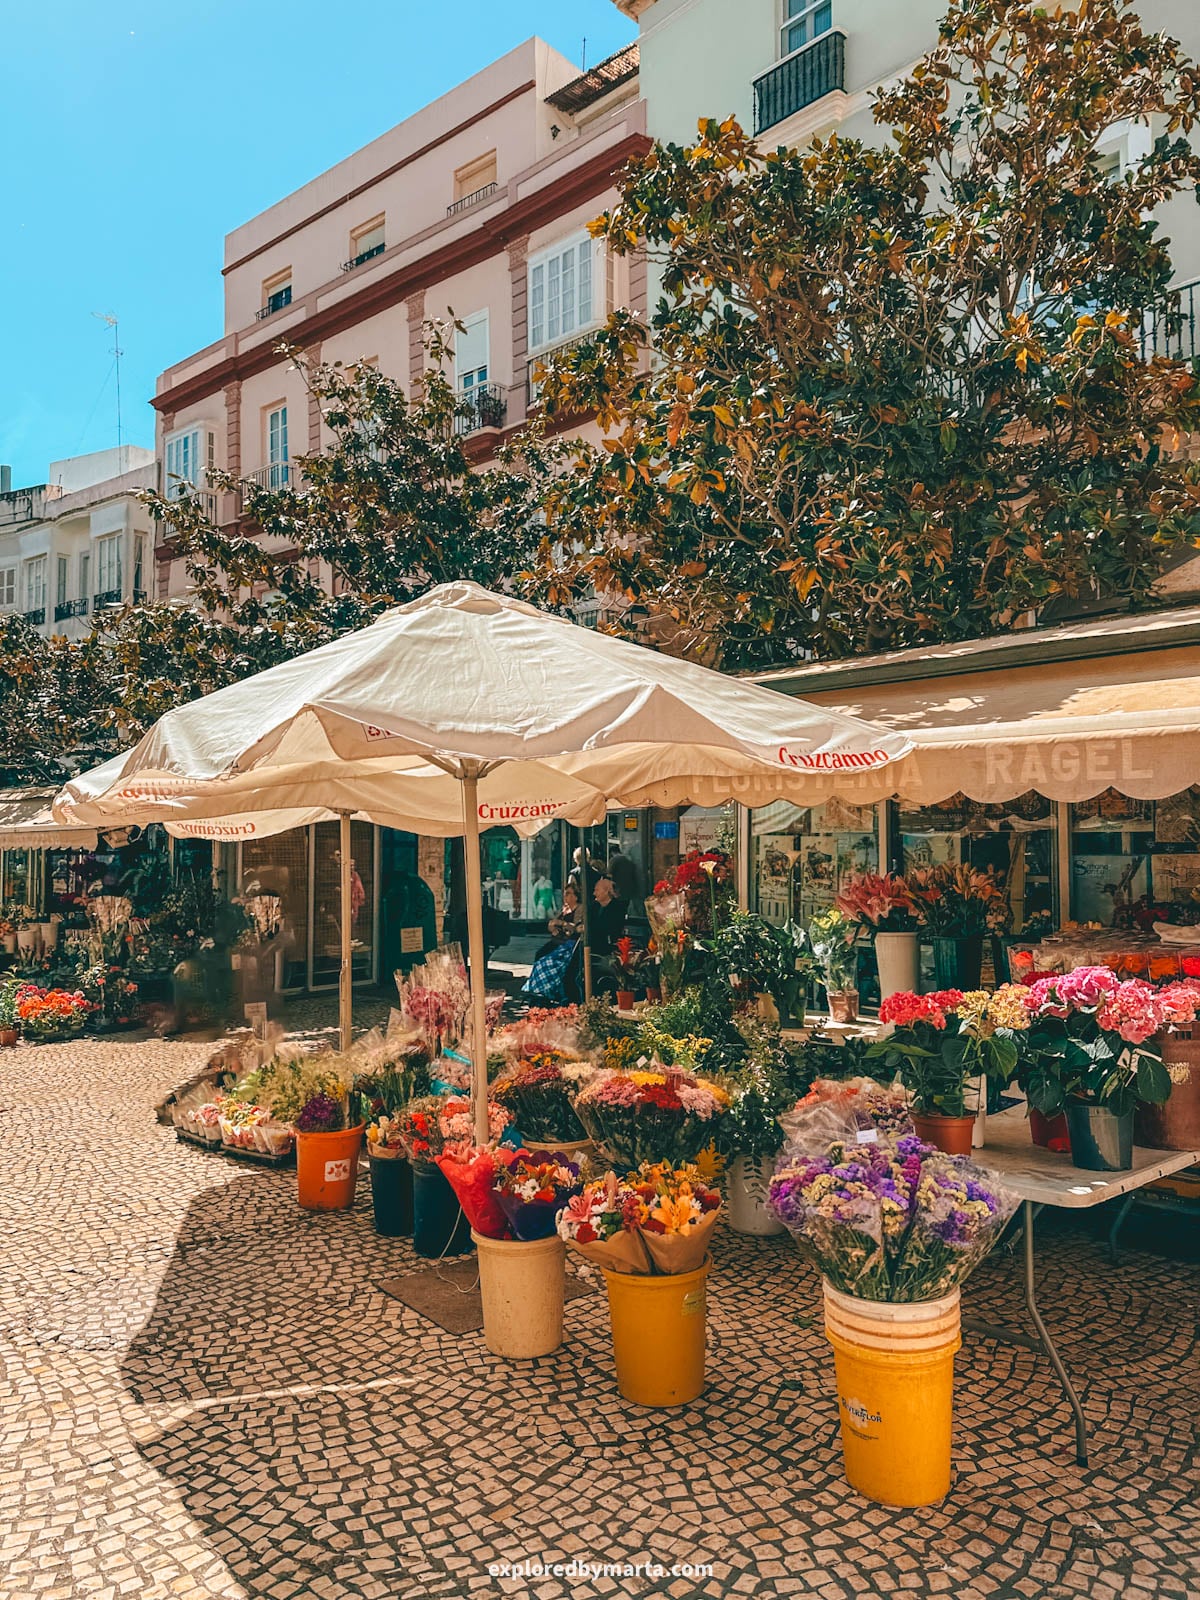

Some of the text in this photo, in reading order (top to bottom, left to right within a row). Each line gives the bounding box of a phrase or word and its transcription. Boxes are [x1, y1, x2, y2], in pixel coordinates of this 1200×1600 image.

[779, 746, 889, 769] Cruzcampo
[986, 739, 1153, 784] RAGEL
[478, 801, 569, 819] Cruzcam
